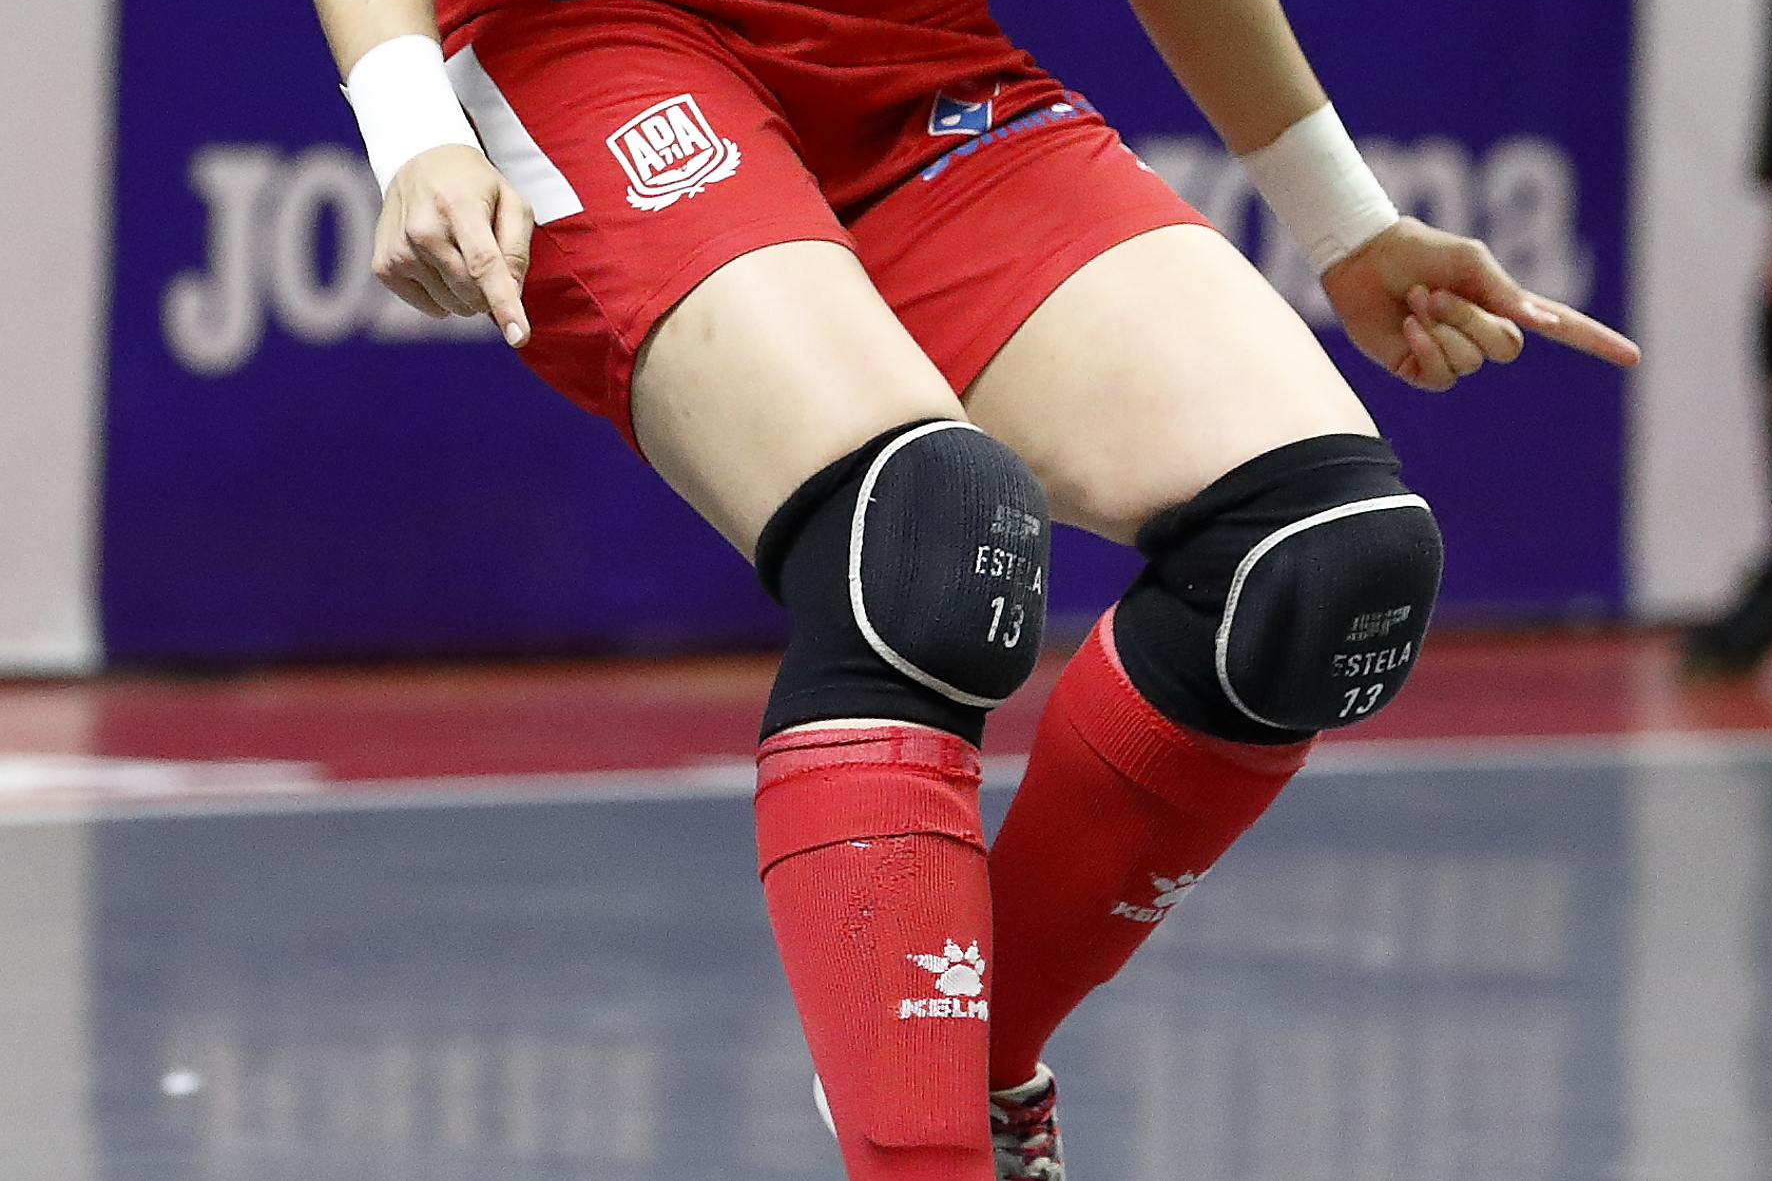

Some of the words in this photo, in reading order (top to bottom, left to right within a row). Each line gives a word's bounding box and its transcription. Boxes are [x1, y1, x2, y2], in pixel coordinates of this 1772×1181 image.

[987, 596, 1025, 649] 13
[1332, 641, 1413, 678] ESTELA
[1338, 683, 1384, 718] 13
